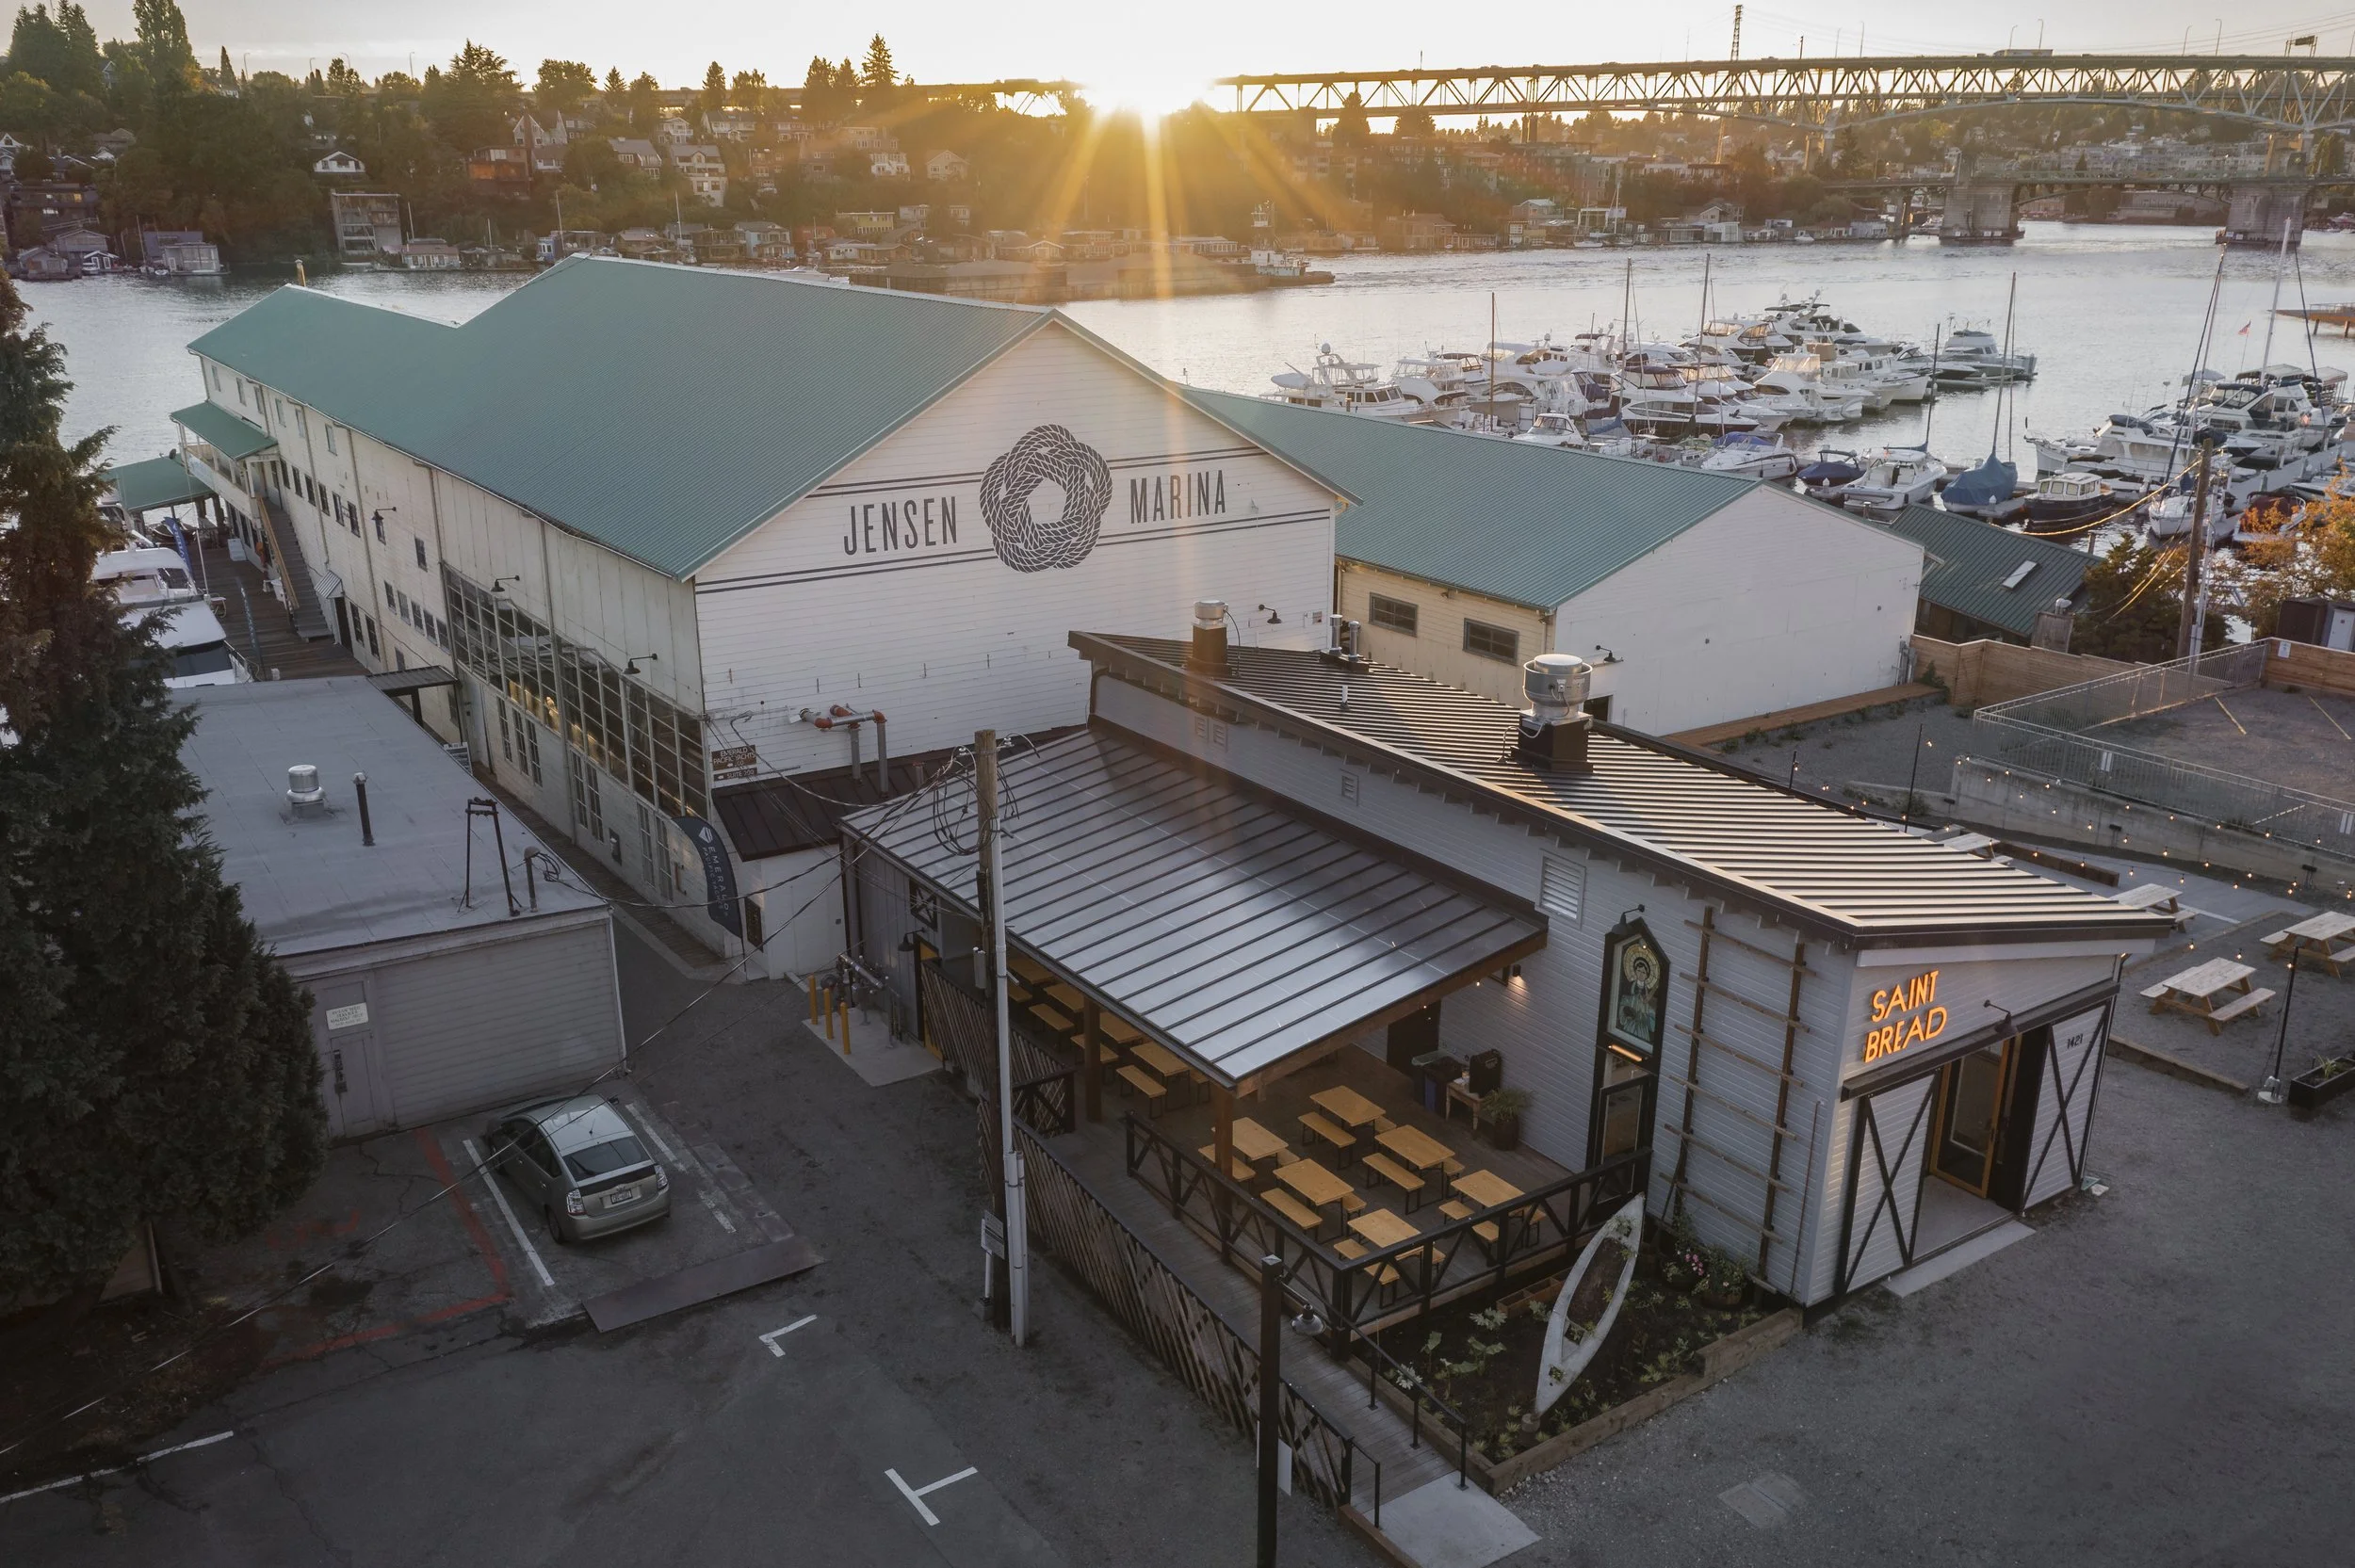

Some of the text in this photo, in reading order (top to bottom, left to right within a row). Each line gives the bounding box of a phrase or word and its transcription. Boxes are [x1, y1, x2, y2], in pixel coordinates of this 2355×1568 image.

[843, 469, 1226, 557] JENSEN MARINA
[720, 747, 748, 757] EMERALD
[702, 847, 716, 879] PACIFIC
[707, 846, 729, 911] EMERALD
[1871, 969, 1940, 1024] SAINT
[1863, 1006, 1948, 1064] BREAD
[2067, 1033, 2084, 1050] 1421
